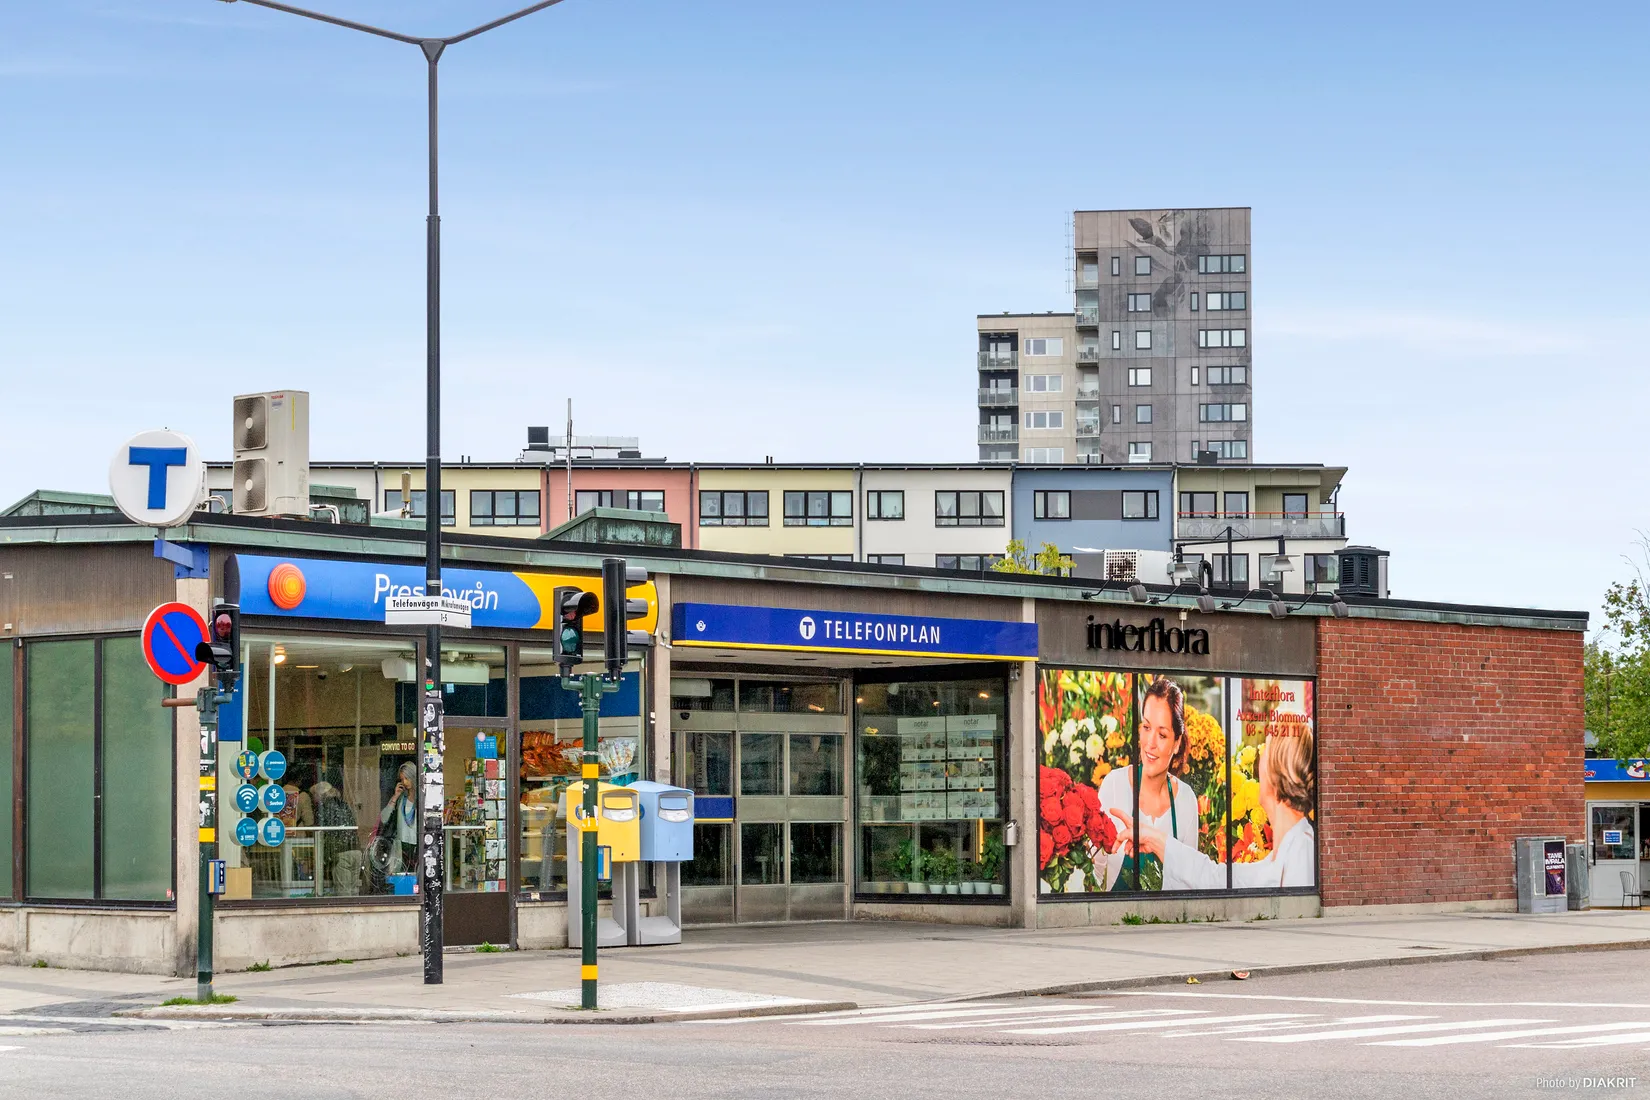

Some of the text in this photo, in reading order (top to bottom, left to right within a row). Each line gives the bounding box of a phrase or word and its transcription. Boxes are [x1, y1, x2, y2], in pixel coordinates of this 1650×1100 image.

[128, 446, 187, 510] T
[392, 599, 439, 609] Telefonvägen
[824, 619, 941, 644] TELEFONPLAN
[1086, 614, 1210, 655] interflora
[1249, 685, 1295, 702] Interflora
[1269, 709, 1311, 723] Blommor
